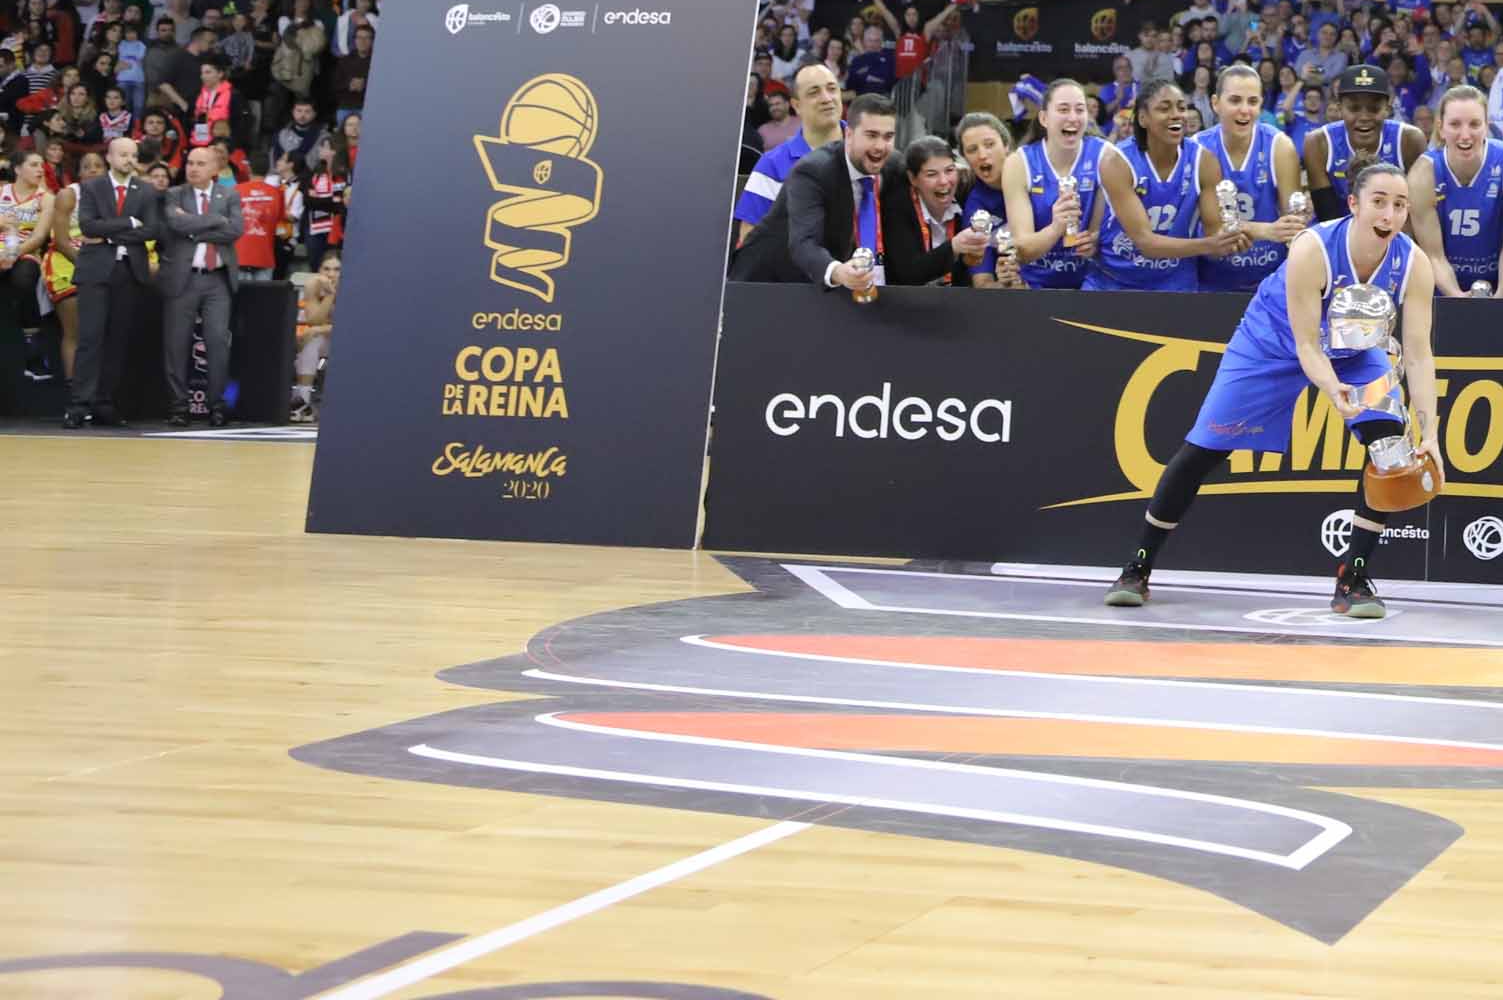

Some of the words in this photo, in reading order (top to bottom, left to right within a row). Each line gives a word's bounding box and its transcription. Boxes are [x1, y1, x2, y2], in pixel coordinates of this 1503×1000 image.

[603, 8, 671, 25] endesa
[1147, 203, 1177, 232] 12
[1448, 208, 1481, 237] 15
[471, 308, 563, 331] endesa
[455, 345, 563, 383] COPA
[441, 399, 464, 416] LA
[466, 384, 569, 419] REINA
[443, 383, 465, 399] DE
[764, 381, 1012, 443] endesa
[502, 479, 551, 500] 2020
